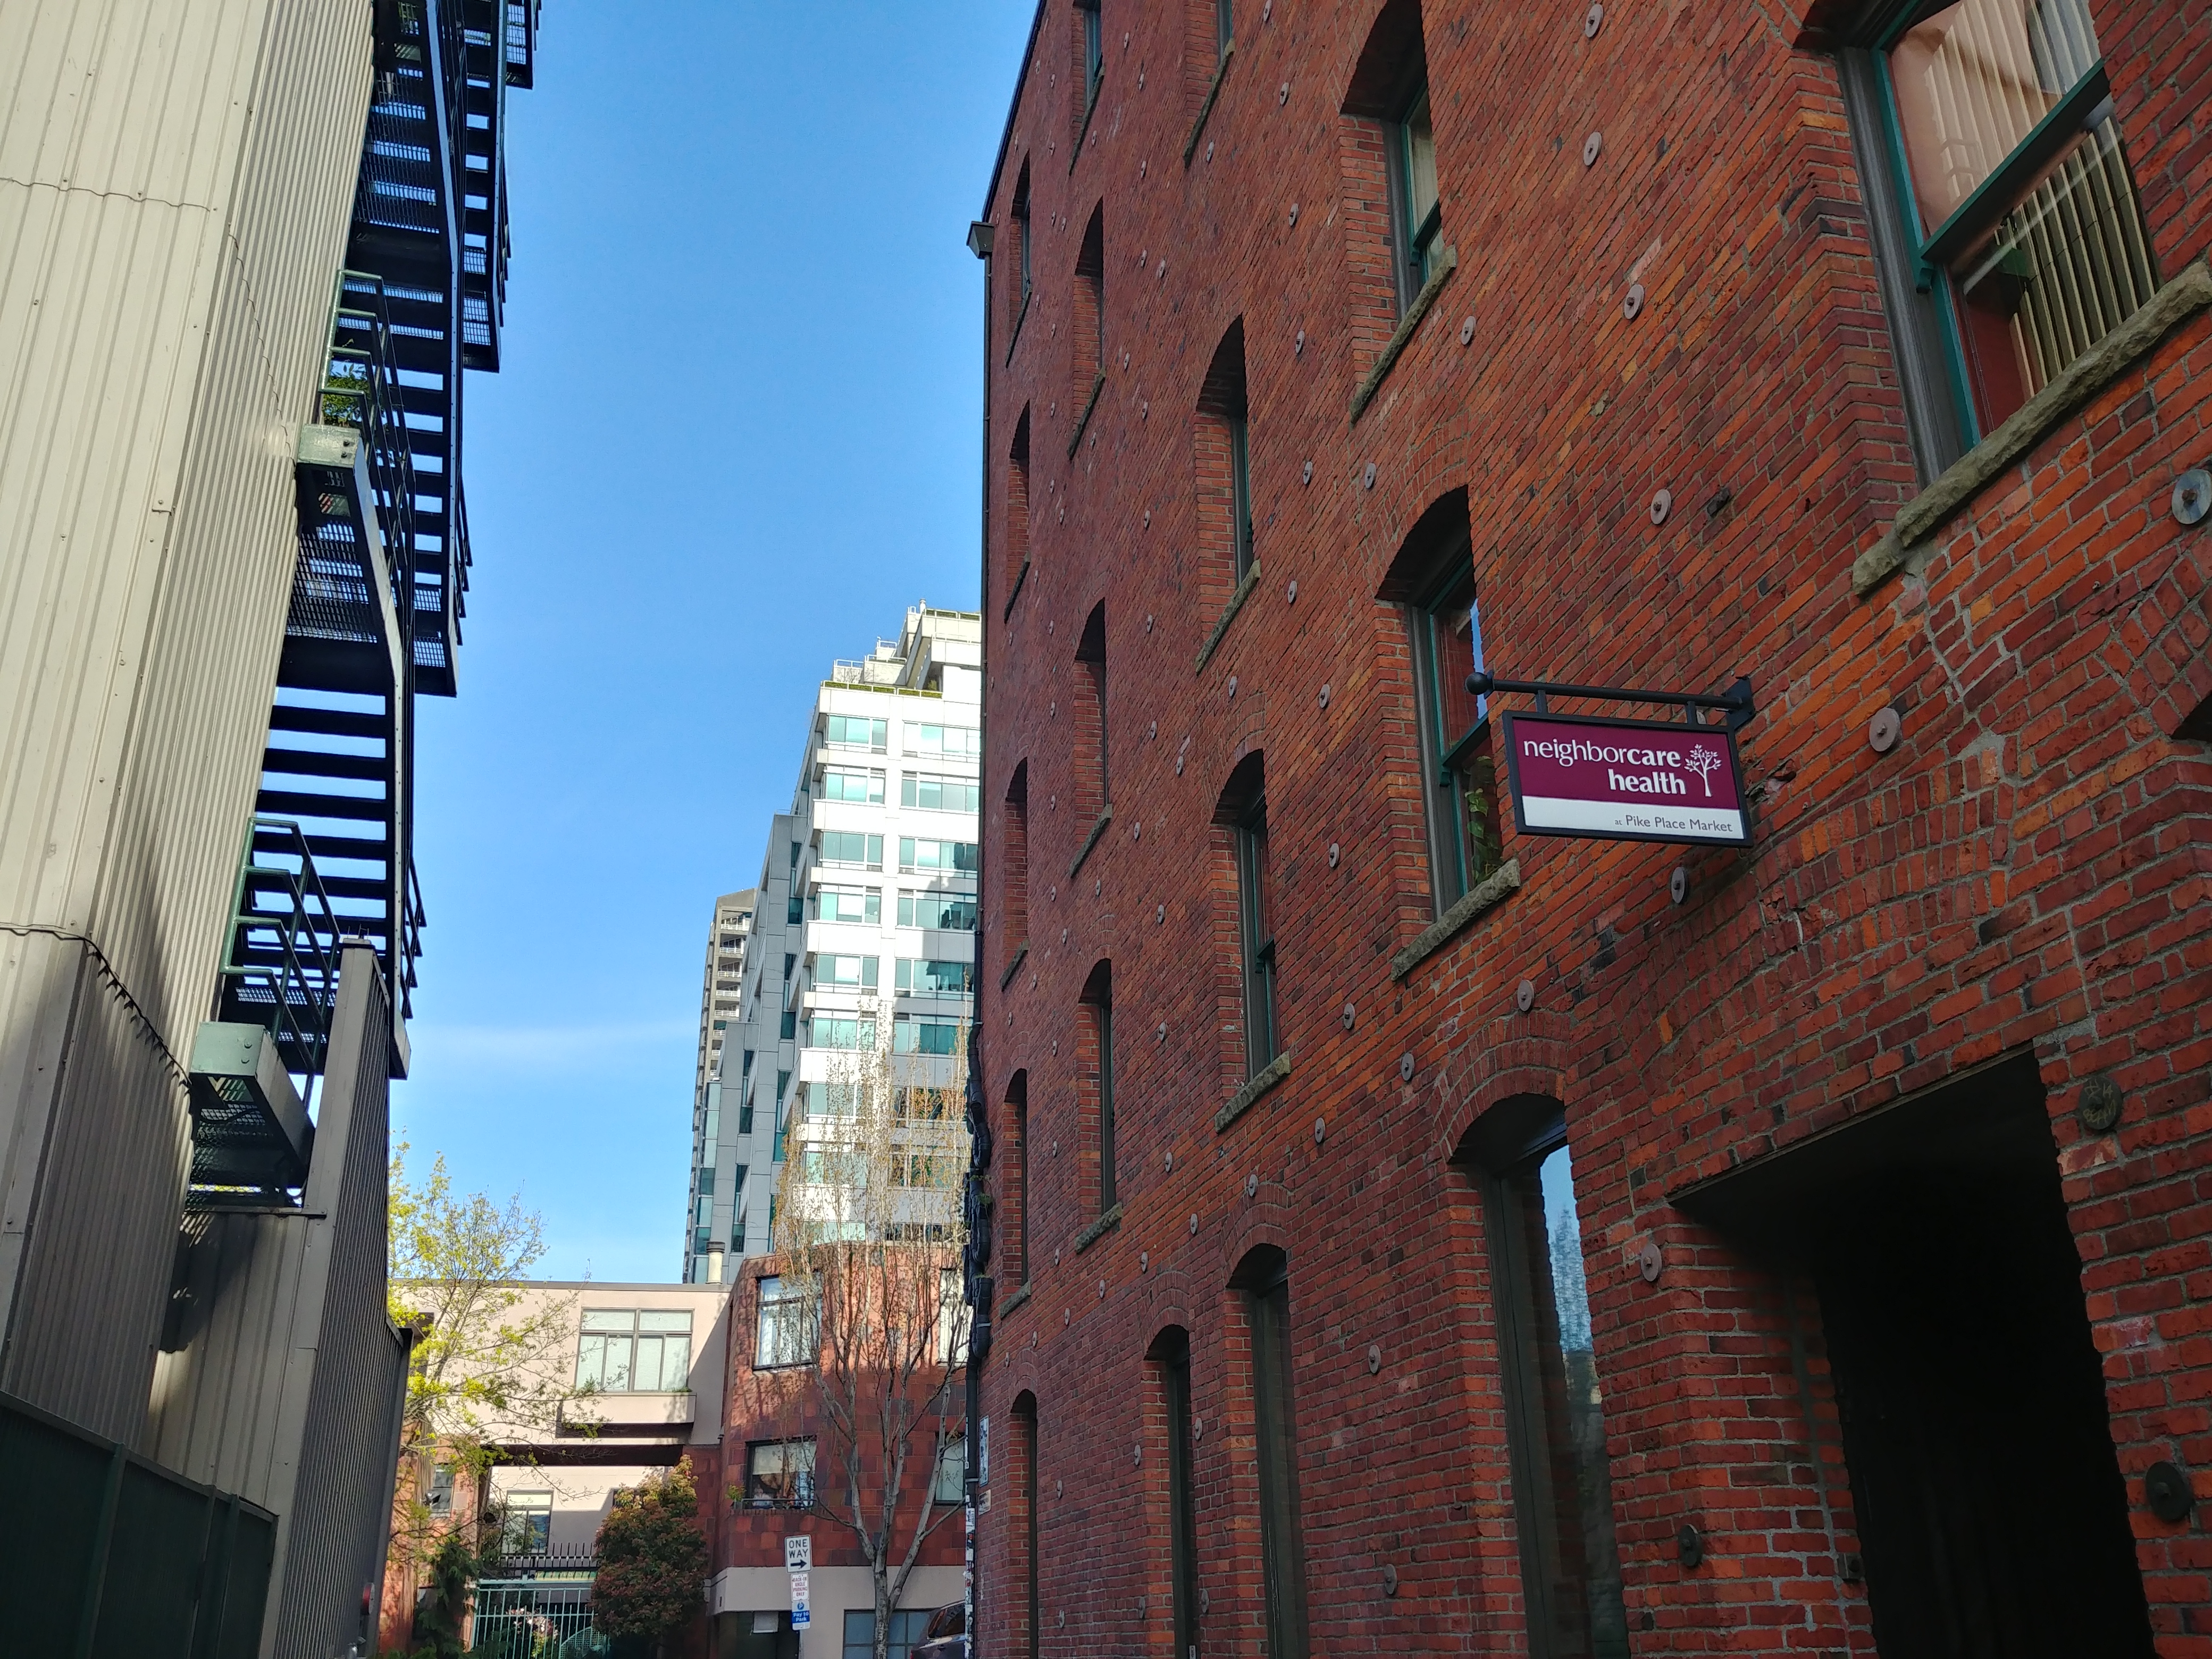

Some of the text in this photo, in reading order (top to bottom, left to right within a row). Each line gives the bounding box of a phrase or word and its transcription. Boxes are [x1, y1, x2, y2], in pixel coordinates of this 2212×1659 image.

[1523, 739, 1681, 767] neighborcare
[1608, 768, 1686, 794] health
[1626, 815, 1651, 827] Pike
[1654, 817, 1686, 829] Place
[1689, 819, 1733, 832] Market
[789, 1539, 808, 1548] ONE
[789, 1548, 808, 1559] WAY
